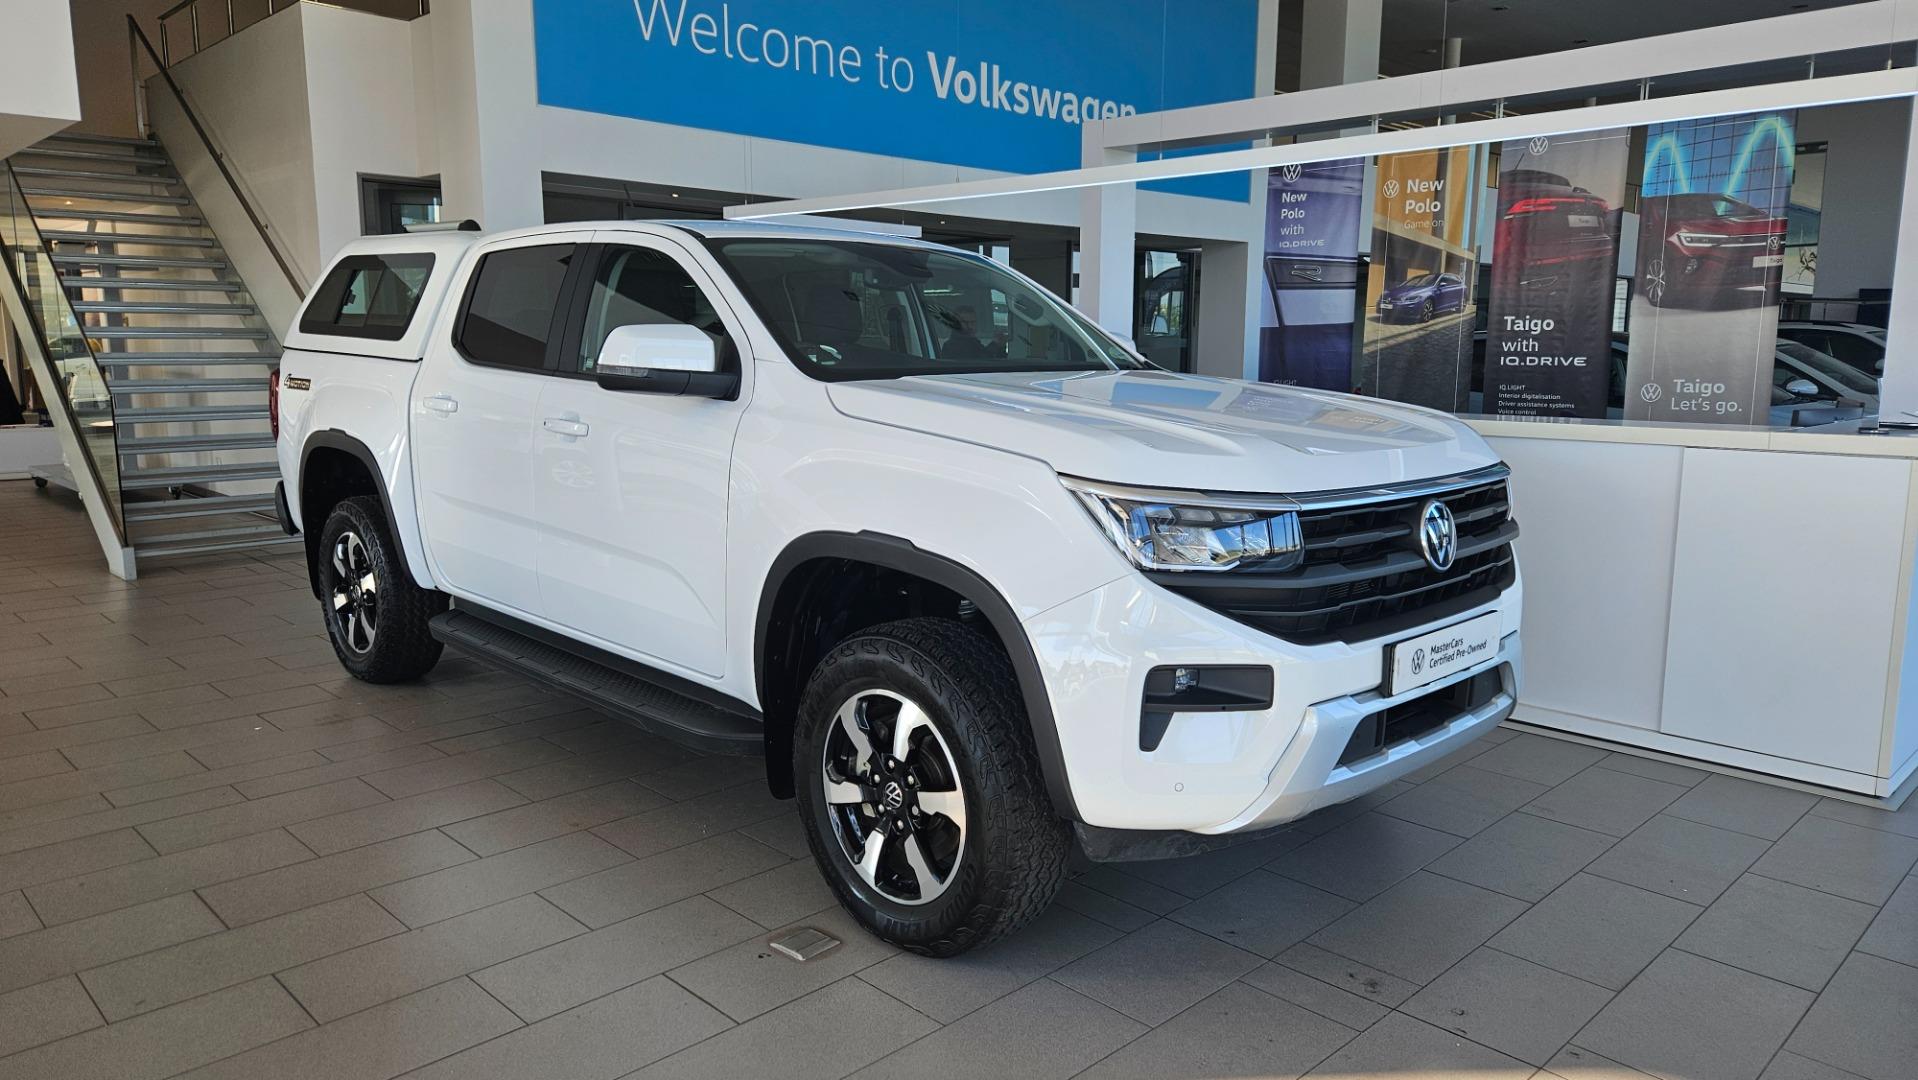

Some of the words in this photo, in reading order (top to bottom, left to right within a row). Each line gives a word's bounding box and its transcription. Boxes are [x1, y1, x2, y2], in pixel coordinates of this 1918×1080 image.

[633, 0, 861, 82] Welcome
[875, 46, 914, 92] to
[1406, 178, 1444, 194] New
[1281, 191, 1308, 204] New
[1280, 207, 1305, 220] Polo
[1405, 198, 1441, 214] Polo
[1280, 223, 1305, 236] with
[1404, 219, 1431, 230] Game
[1431, 219, 1444, 228] on
[1279, 239, 1326, 249] IQ.DRIVE
[1504, 315, 1555, 335] Taigo
[1502, 338, 1539, 352] with
[1500, 356, 1588, 368] IQ.DRIVE
[1673, 379, 1725, 395] Taigo
[1671, 398, 1710, 412] Let's
[1716, 400, 1742, 414] go.
[1429, 650, 1456, 669] Certified
[1455, 640, 1488, 659] Pre-Owned
[1430, 637, 1464, 656] MasterCars
